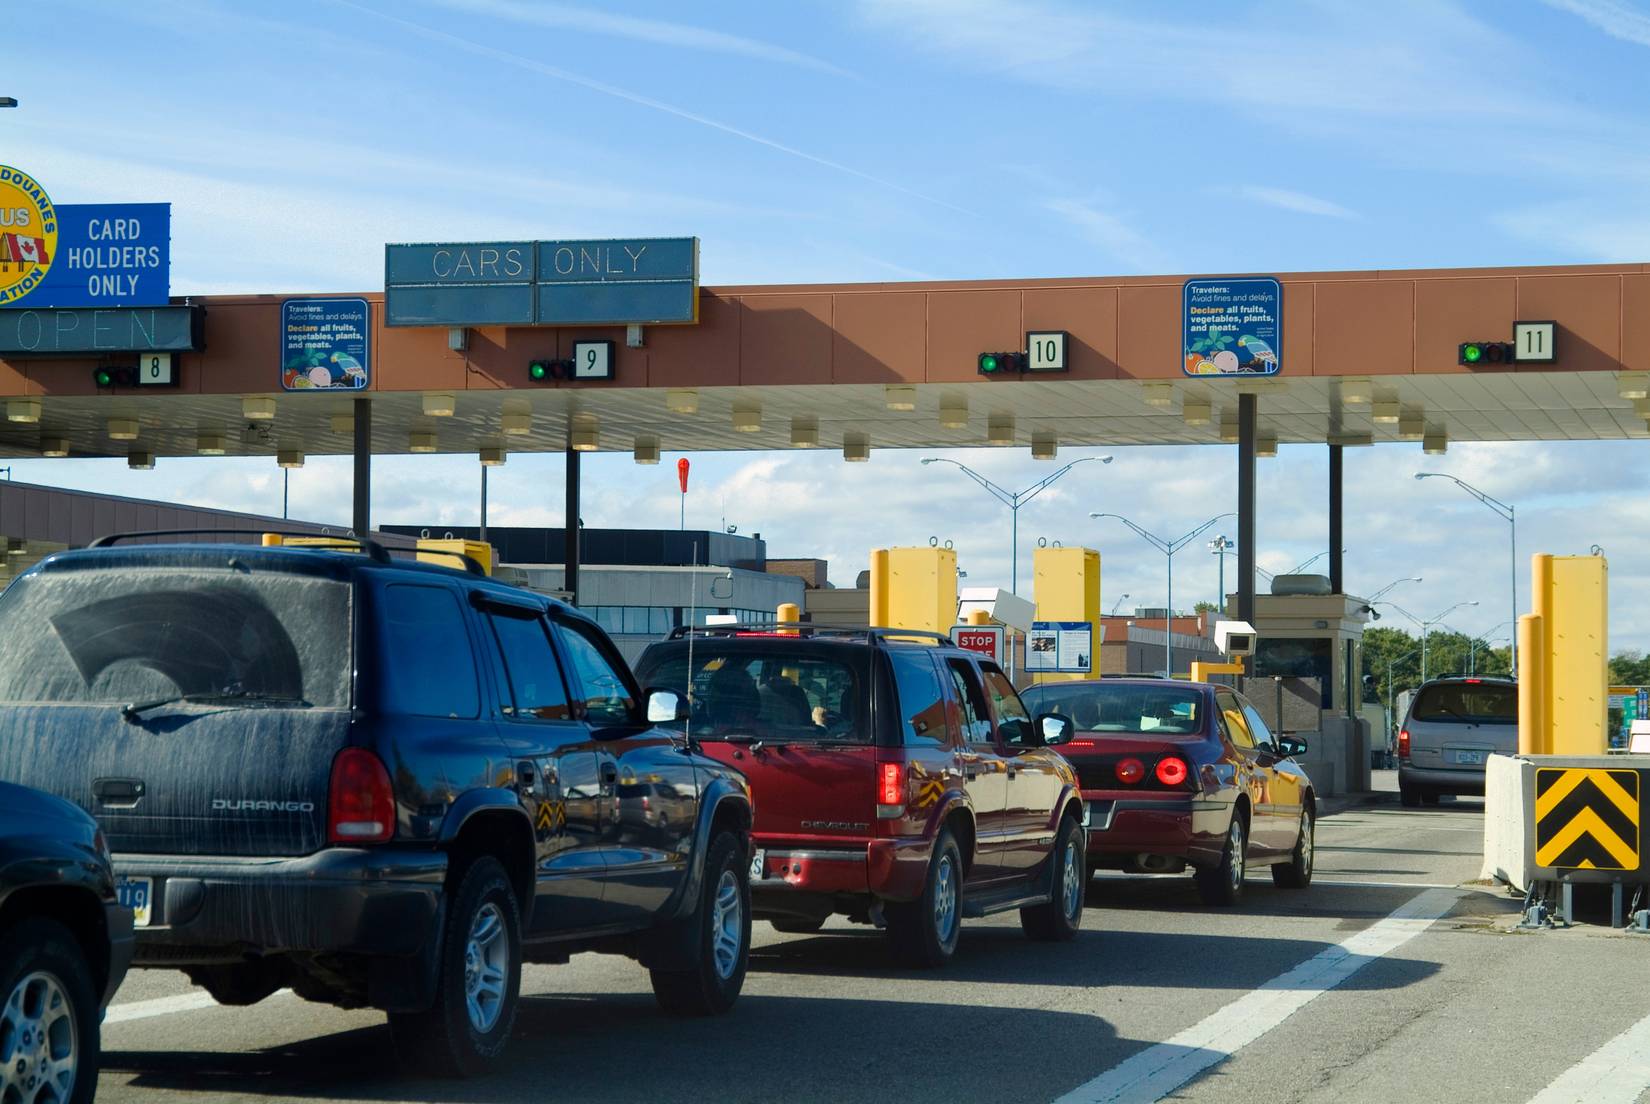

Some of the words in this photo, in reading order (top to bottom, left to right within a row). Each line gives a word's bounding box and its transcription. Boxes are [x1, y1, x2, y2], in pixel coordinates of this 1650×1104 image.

[1, 168, 55, 233] DOUANES
[88, 218, 141, 241] CARD
[68, 246, 160, 269] HOLDERS
[432, 249, 523, 278] CARS
[554, 245, 646, 275] ONLY
[88, 275, 139, 296] ONLY
[1191, 294, 1212, 302] Avoid
[1213, 294, 1231, 302] fines
[288, 305, 324, 313] Travelers:
[1190, 306, 1224, 314] Declare
[1226, 305, 1238, 313] all
[1240, 305, 1266, 314] fruits,
[308, 312, 325, 320] fines
[325, 312, 339, 320] and
[1190, 315, 1242, 324] vegetables,
[1243, 314, 1274, 323] plants,
[17, 309, 155, 350] OPEN
[288, 324, 318, 332] Declare
[332, 323, 356, 332] fruits,
[1190, 324, 1207, 332] and
[1209, 323, 1240, 331] meats.
[288, 333, 334, 342] vegetables,
[335, 332, 364, 341] plants,
[1526, 330, 1543, 353] 11
[288, 341, 303, 349] and
[304, 341, 332, 349] meats.
[1036, 340, 1056, 362] 10
[586, 349, 597, 370] 9
[150, 356, 160, 378] 8
[961, 636, 993, 646] STOP
[212, 799, 315, 812] DURANGO
[800, 820, 870, 830] CHEVROLET
